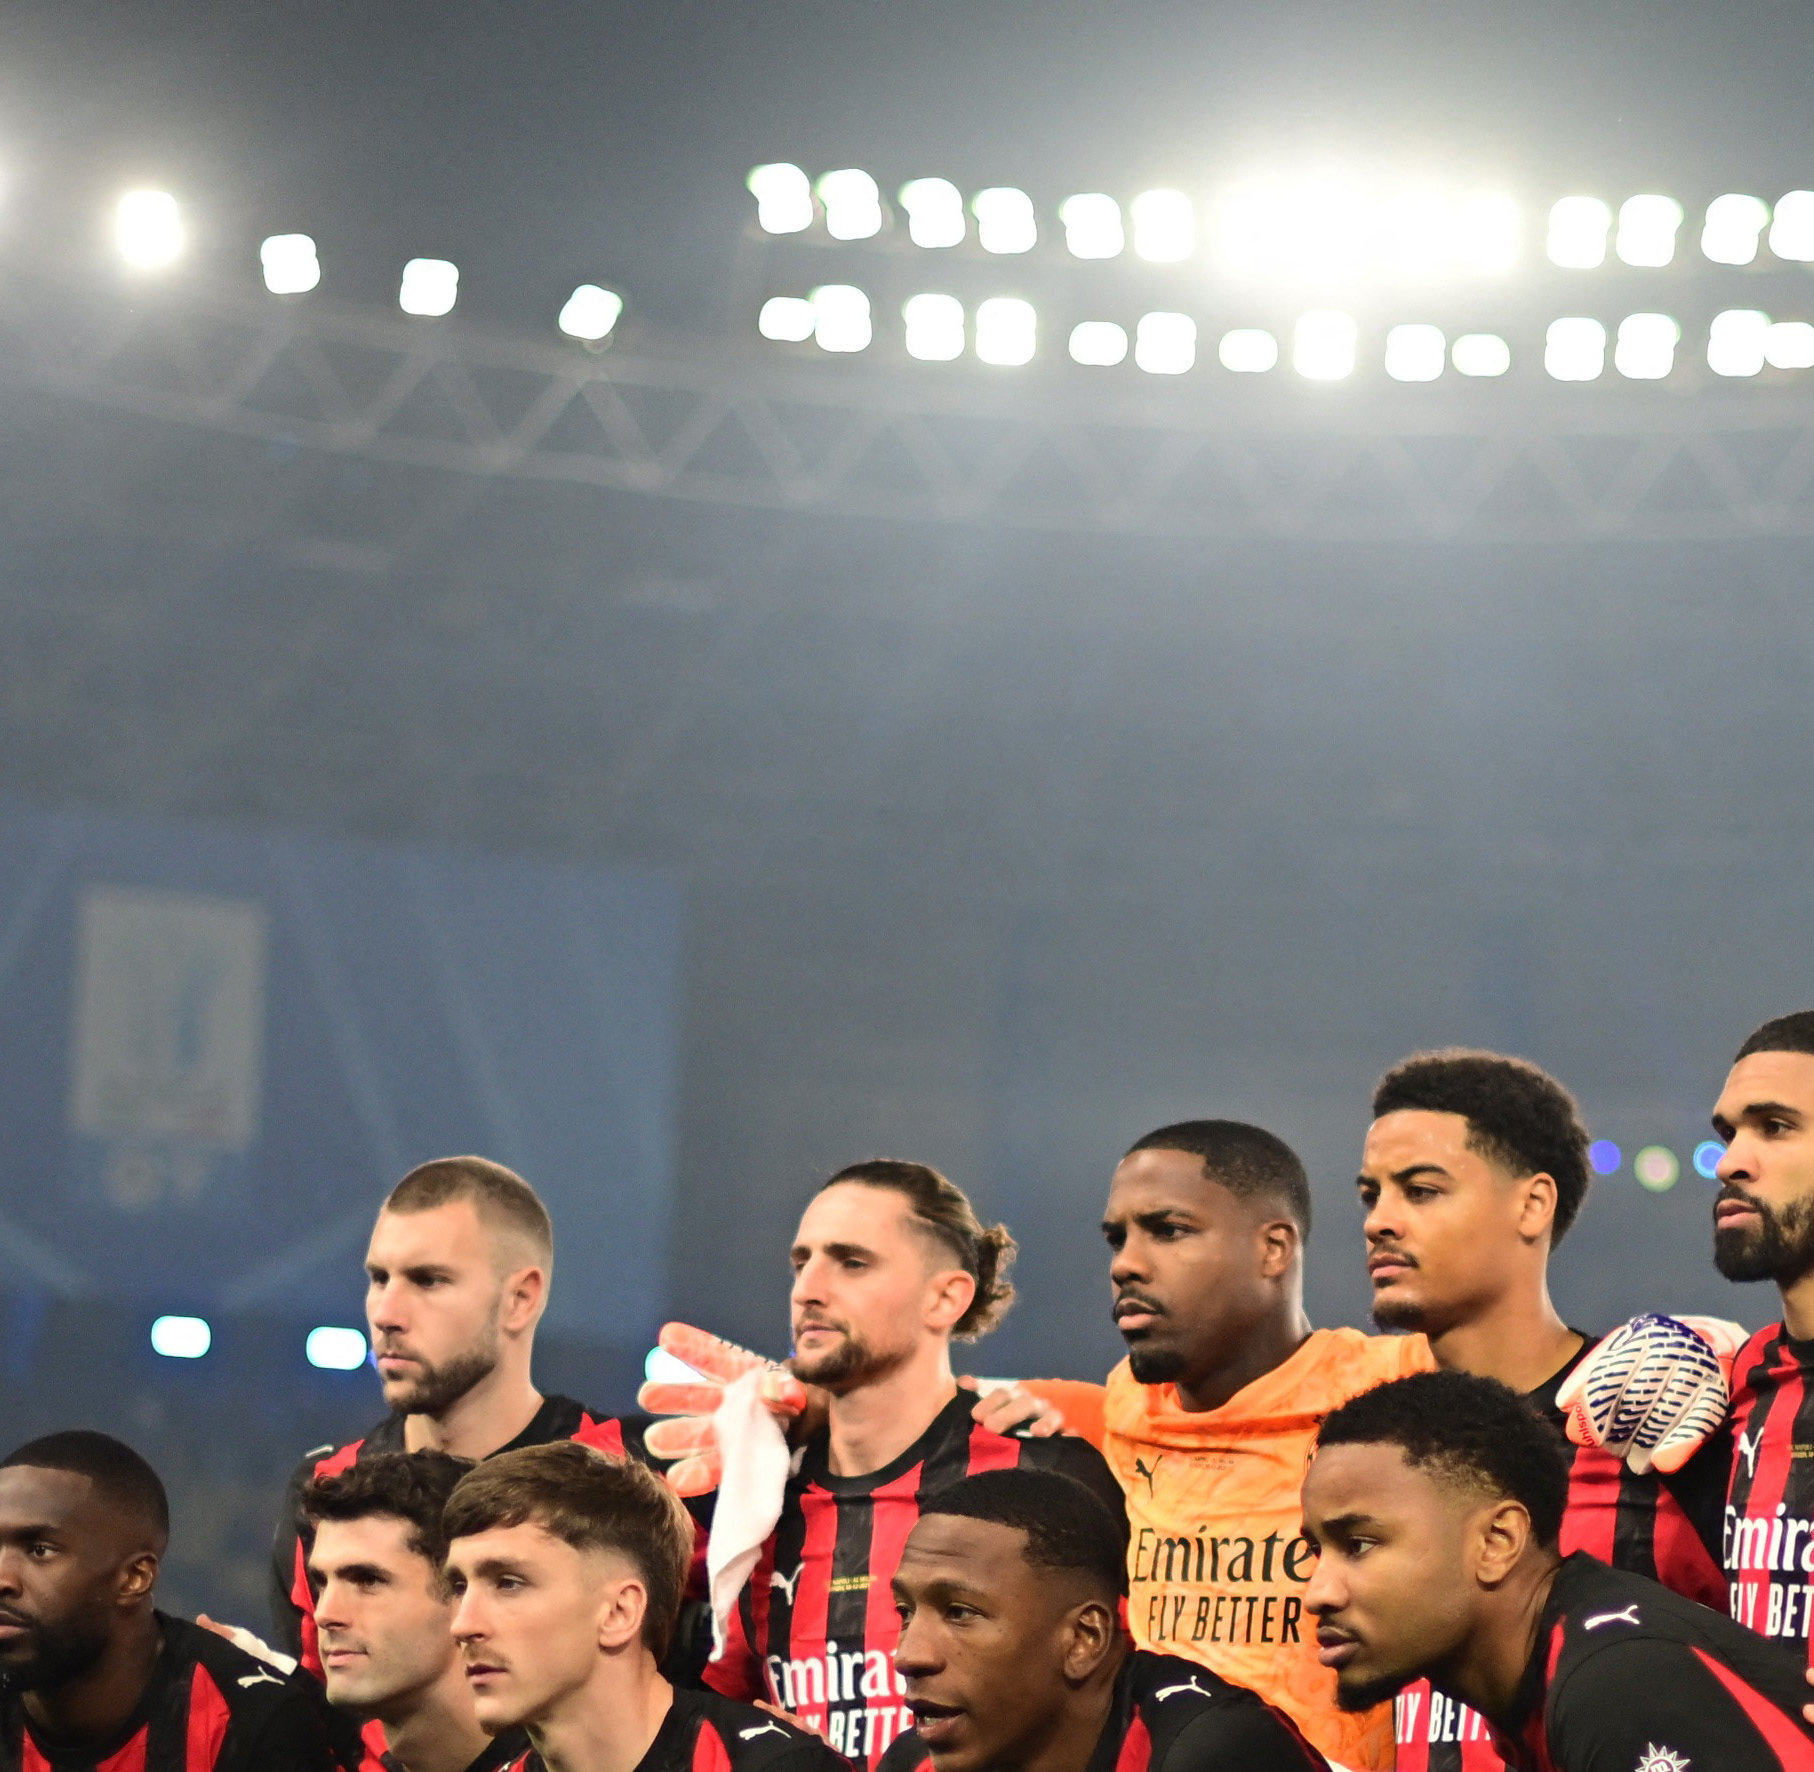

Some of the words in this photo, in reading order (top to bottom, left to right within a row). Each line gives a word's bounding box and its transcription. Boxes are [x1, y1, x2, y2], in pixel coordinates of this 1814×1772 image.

[1133, 1524, 1314, 1583] Emirate
[1148, 1595, 1186, 1642] FLY
[1191, 1596, 1302, 1643] BETTER
